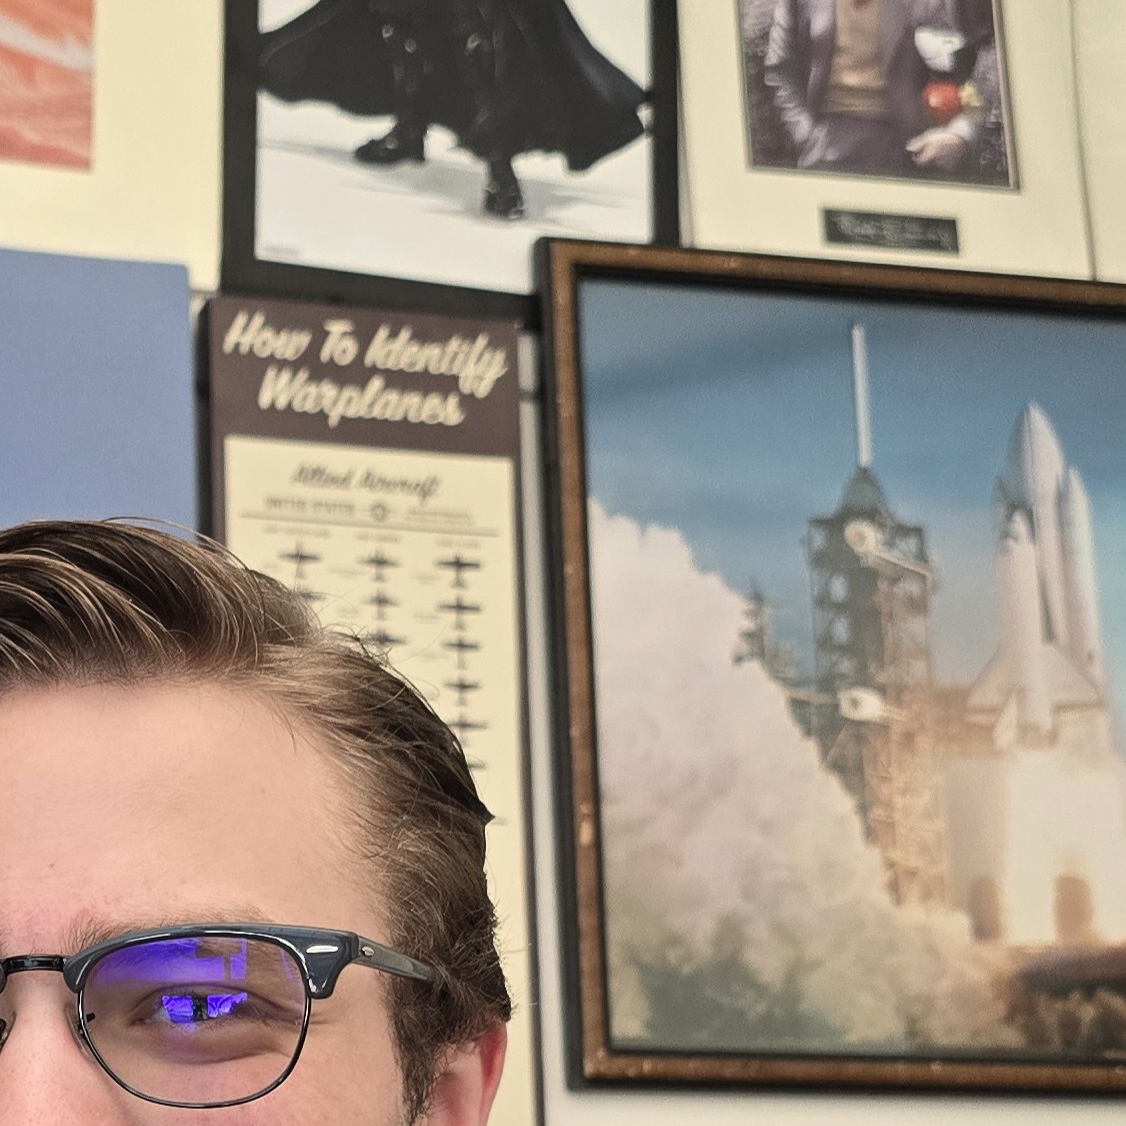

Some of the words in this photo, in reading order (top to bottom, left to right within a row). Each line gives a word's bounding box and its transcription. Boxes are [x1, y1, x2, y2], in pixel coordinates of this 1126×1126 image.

[224, 309, 312, 362] How
[320, 319, 361, 367] To
[364, 323, 508, 399] Identify
[258, 365, 466, 429] Warplanes
